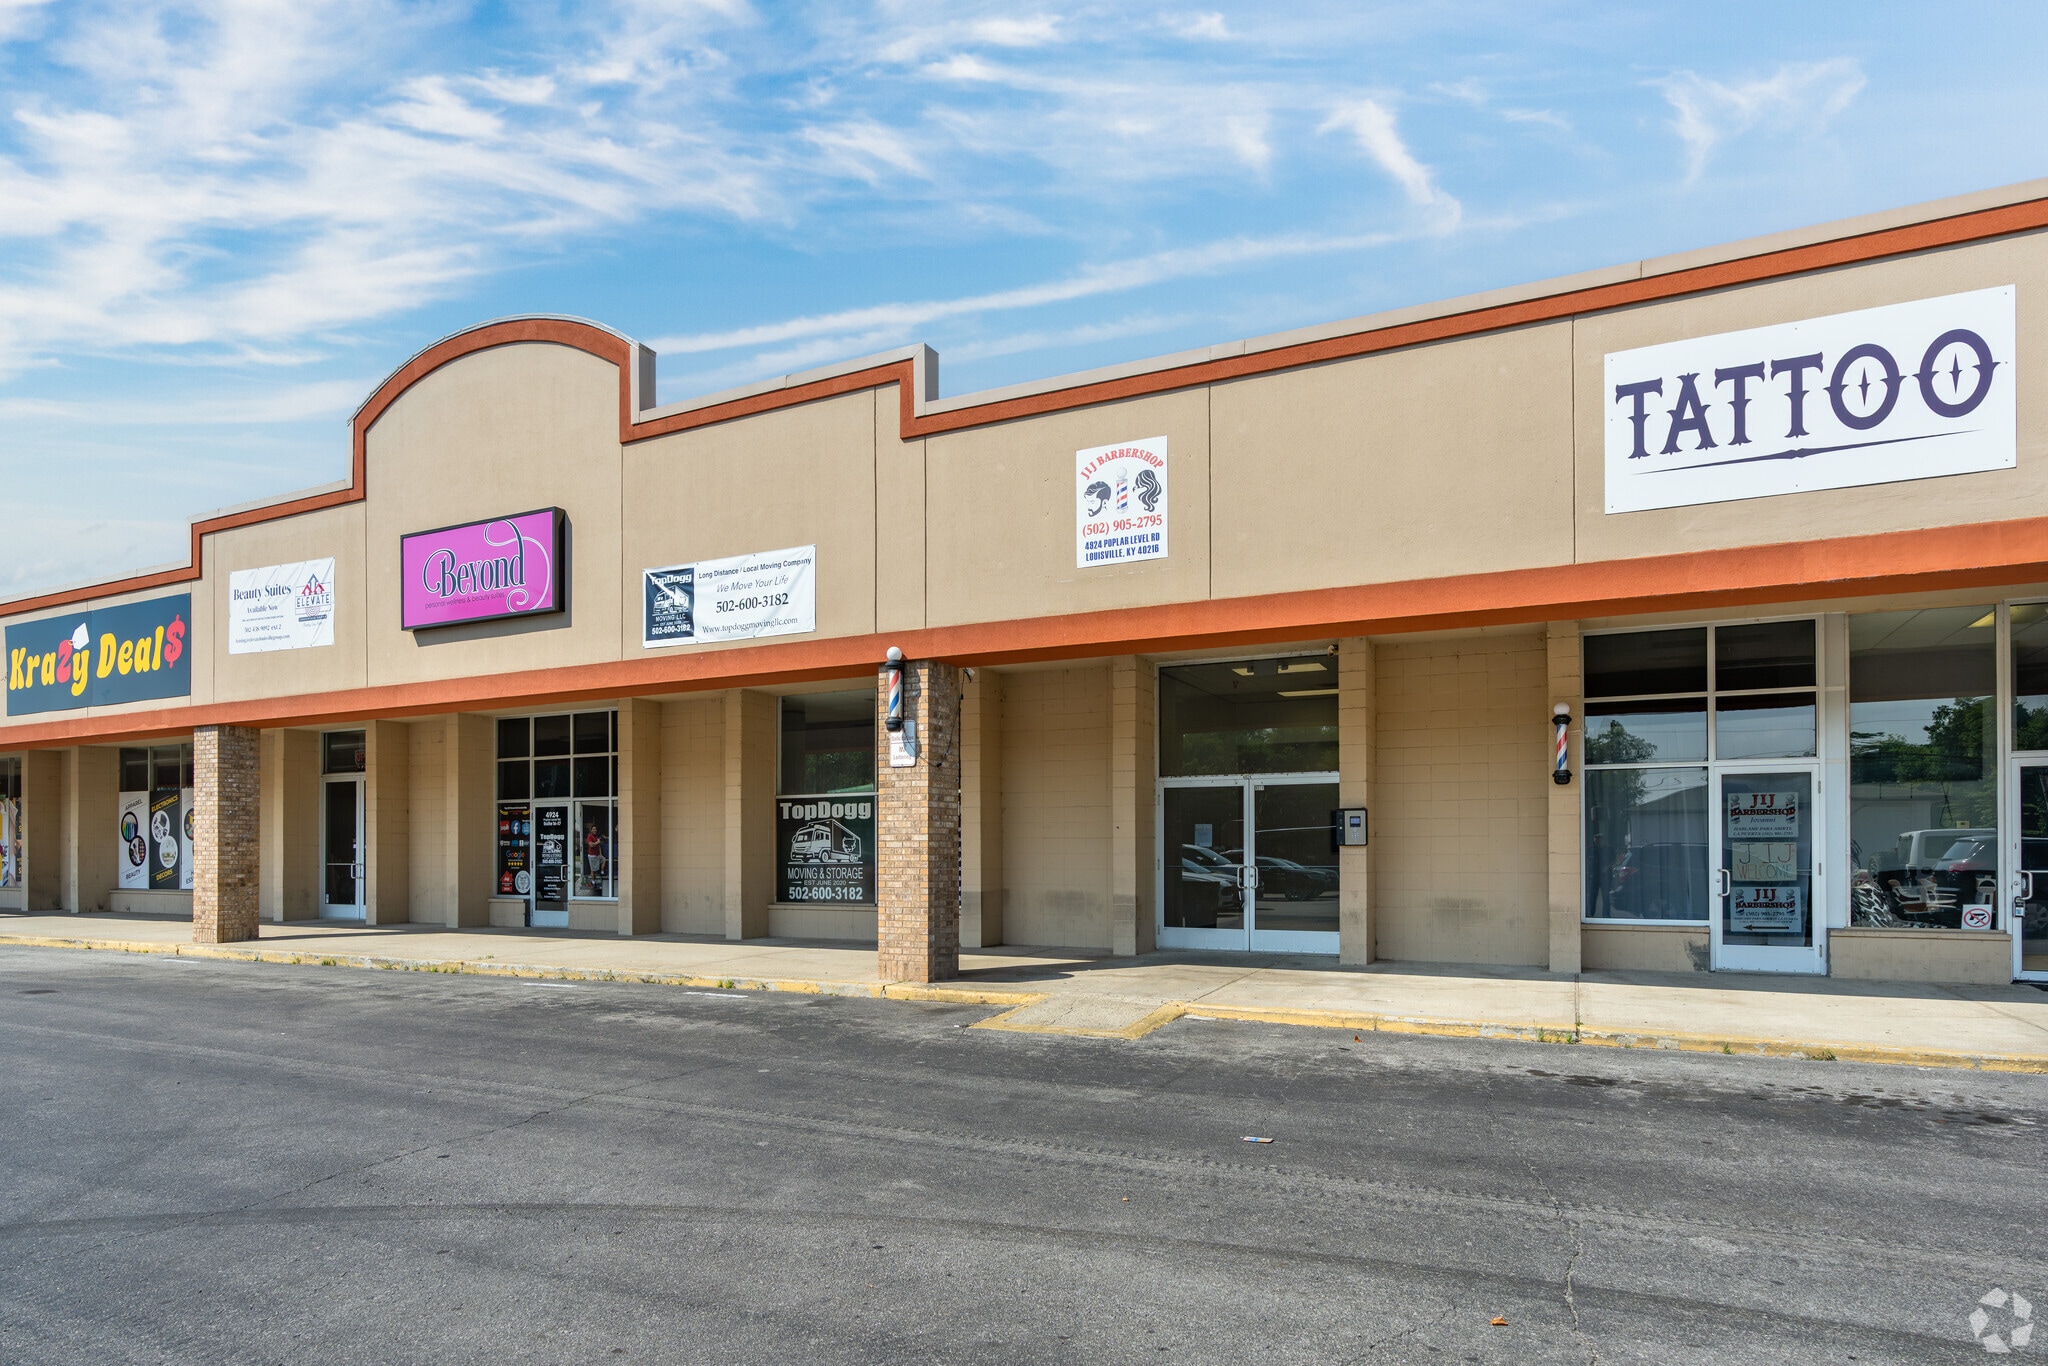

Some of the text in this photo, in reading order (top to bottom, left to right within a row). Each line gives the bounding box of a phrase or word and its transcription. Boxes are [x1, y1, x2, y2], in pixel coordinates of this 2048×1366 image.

[1615, 328, 2001, 460] TATTOO
[1080, 448, 1164, 480] JIJ BARBERSHOP
[1082, 514, 1162, 538] (502) 905-2795
[1103, 536, 1129, 548] POPLAR
[1130, 533, 1149, 544] LEVEL
[1151, 532, 1160, 541] RD
[1126, 547, 1136, 557] KY
[1137, 544, 1160, 555] 40216
[422, 519, 532, 601] Beyond
[698, 572, 713, 580] Long
[713, 567, 739, 577] Distance
[742, 564, 759, 573] Local
[760, 561, 782, 572] Moving
[783, 557, 812, 568] Company
[717, 574, 789, 593] We Move Your Life
[233, 583, 292, 602] Beauty Suites
[296, 593, 330, 608] ELEVATE
[715, 593, 789, 613] 502-600-3182
[651, 624, 691, 635] 502-600-3182
[702, 616, 799, 634] Www.topdoggmovingllc.com
[9, 614, 186, 697] Krazy Deal$
[124, 799, 143, 811] APPAREL
[151, 795, 179, 812] ELECTRONICS
[1750, 793, 1776, 808] JIJ
[780, 801, 872, 820] TopDogg
[1730, 808, 1796, 817] BARBERSHOP
[125, 868, 142, 880] BEAUTY
[156, 868, 173, 880] DECORS
[787, 867, 863, 880] MOVING & STORAGE
[1737, 863, 1793, 880] WELCOME
[788, 886, 863, 900] 502-600-3182
[1753, 888, 1777, 902] JIJ
[1735, 901, 1796, 909] BARBERSHOP
